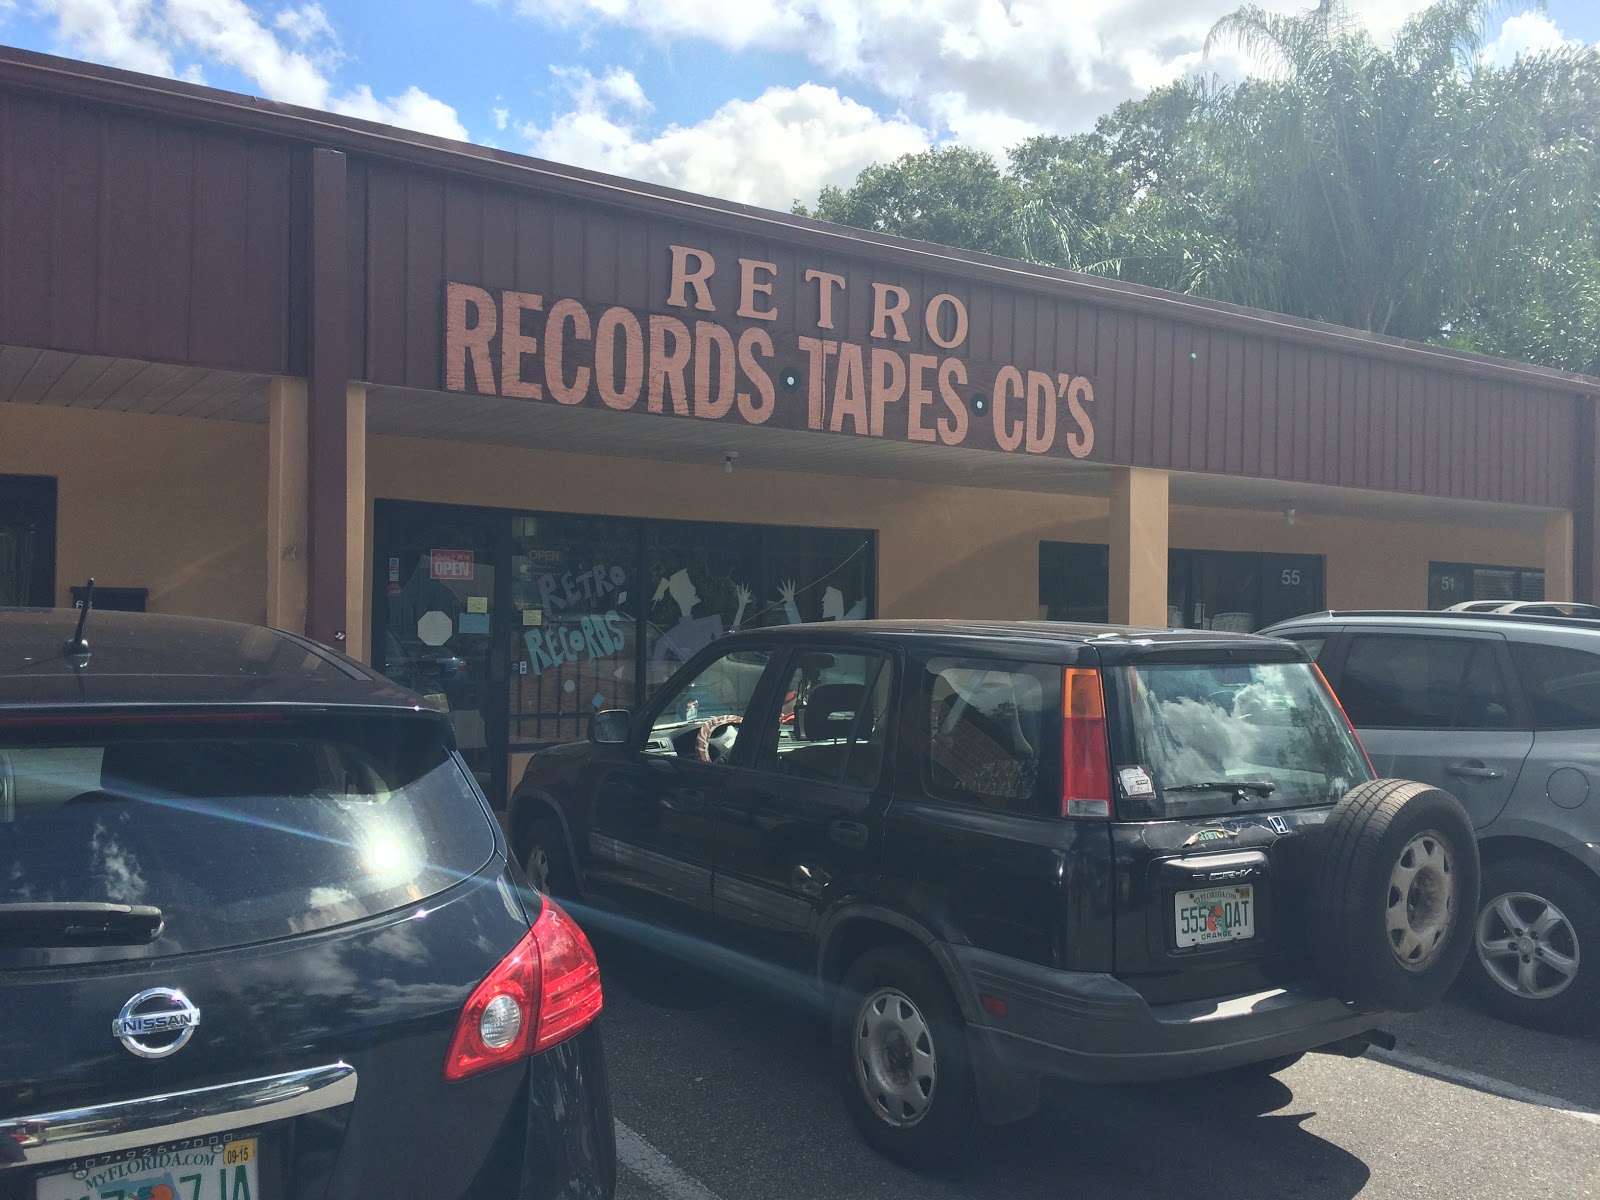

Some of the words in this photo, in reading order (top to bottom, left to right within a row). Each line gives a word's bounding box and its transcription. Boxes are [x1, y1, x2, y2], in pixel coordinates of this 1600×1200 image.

[667, 244, 969, 349] RETRO
[445, 281, 776, 426] RECORDS
[798, 335, 969, 446] TAPES
[993, 364, 1095, 458] CD'S
[528, 549, 560, 561] OPEN
[435, 561, 469, 576] OPEN
[1281, 569, 1301, 586] 55
[537, 565, 626, 617] RETRO
[1441, 576, 1456, 591] 51
[525, 610, 625, 676] RECORDS
[1180, 906, 1208, 934] 555
[1224, 900, 1249, 928] QAT
[1201, 930, 1233, 940] ORANGE
[123, 1012, 193, 1032] NISSAN
[226, 1147, 249, 1164] 09-15
[85, 1153, 216, 1190] MYFLORIDA.COM
